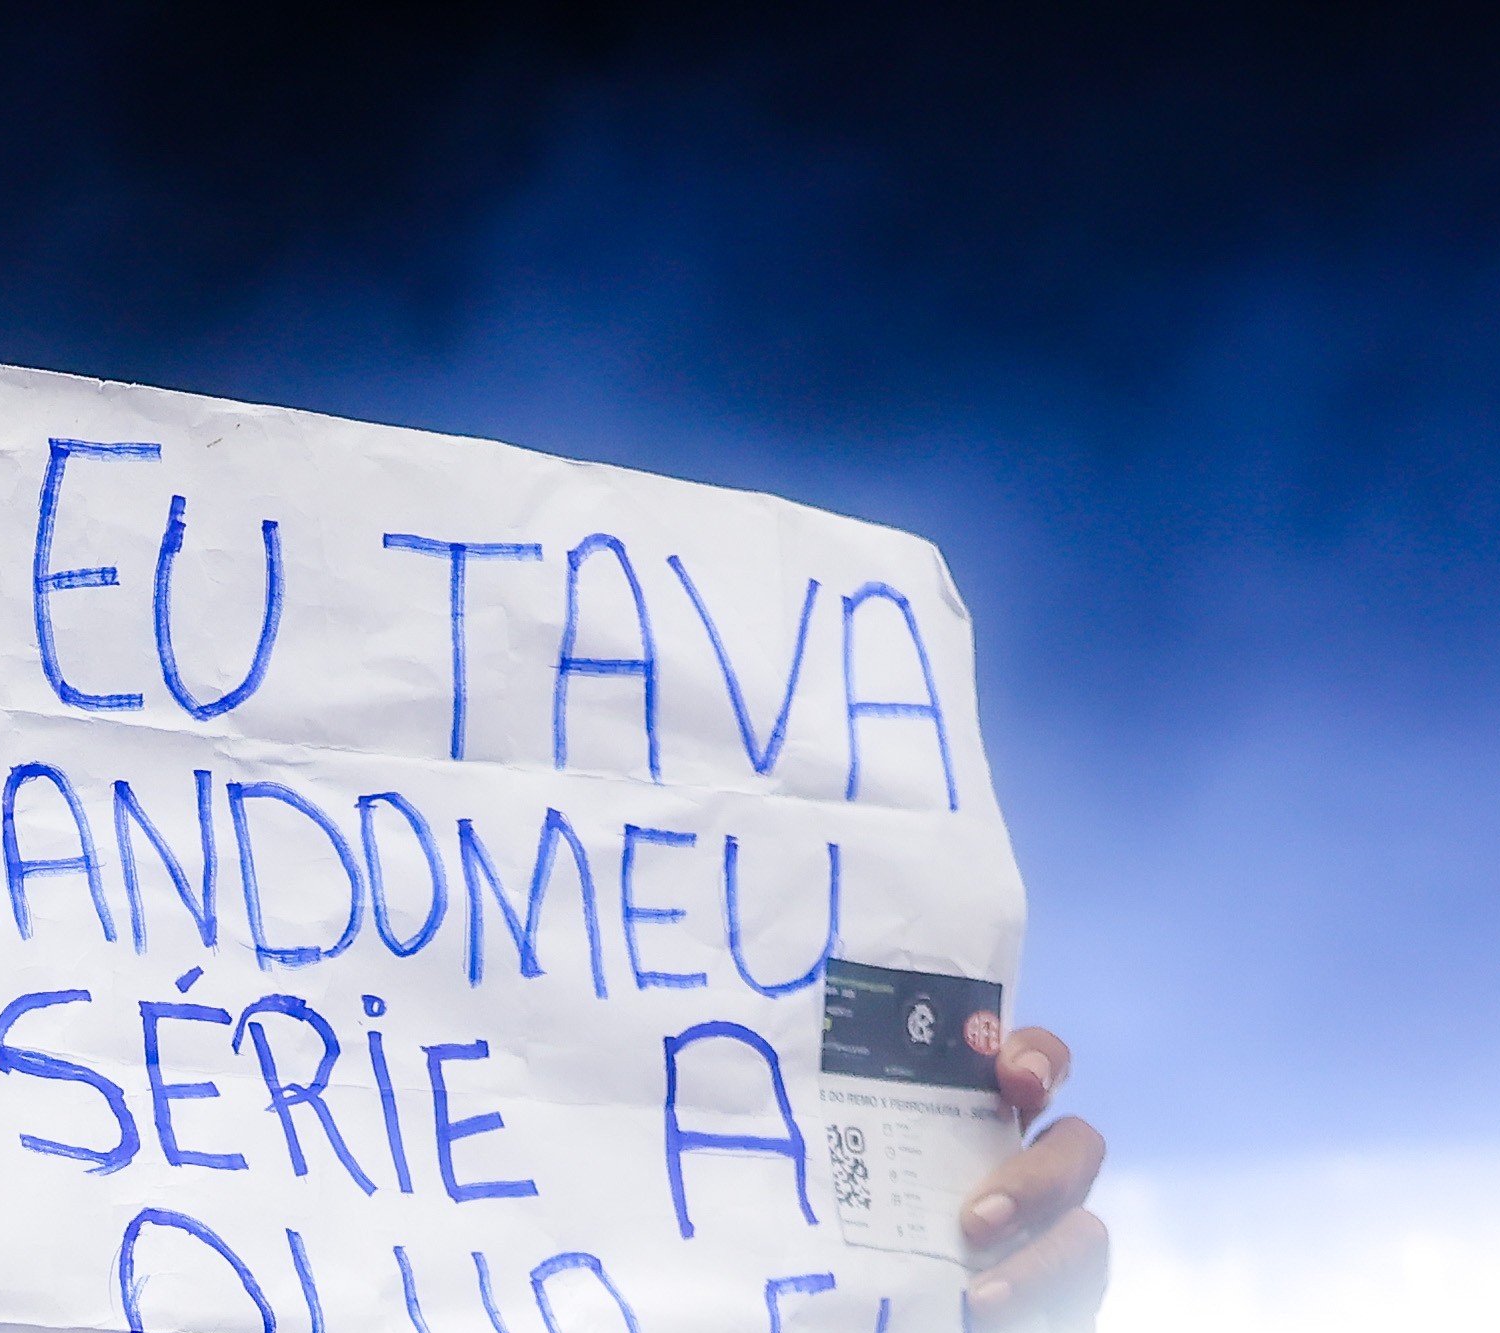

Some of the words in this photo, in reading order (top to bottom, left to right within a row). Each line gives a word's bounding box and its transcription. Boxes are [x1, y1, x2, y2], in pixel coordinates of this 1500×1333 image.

[33, 438, 282, 721] EU
[383, 533, 957, 811] TAVA
[664, 1020, 817, 1238] A
